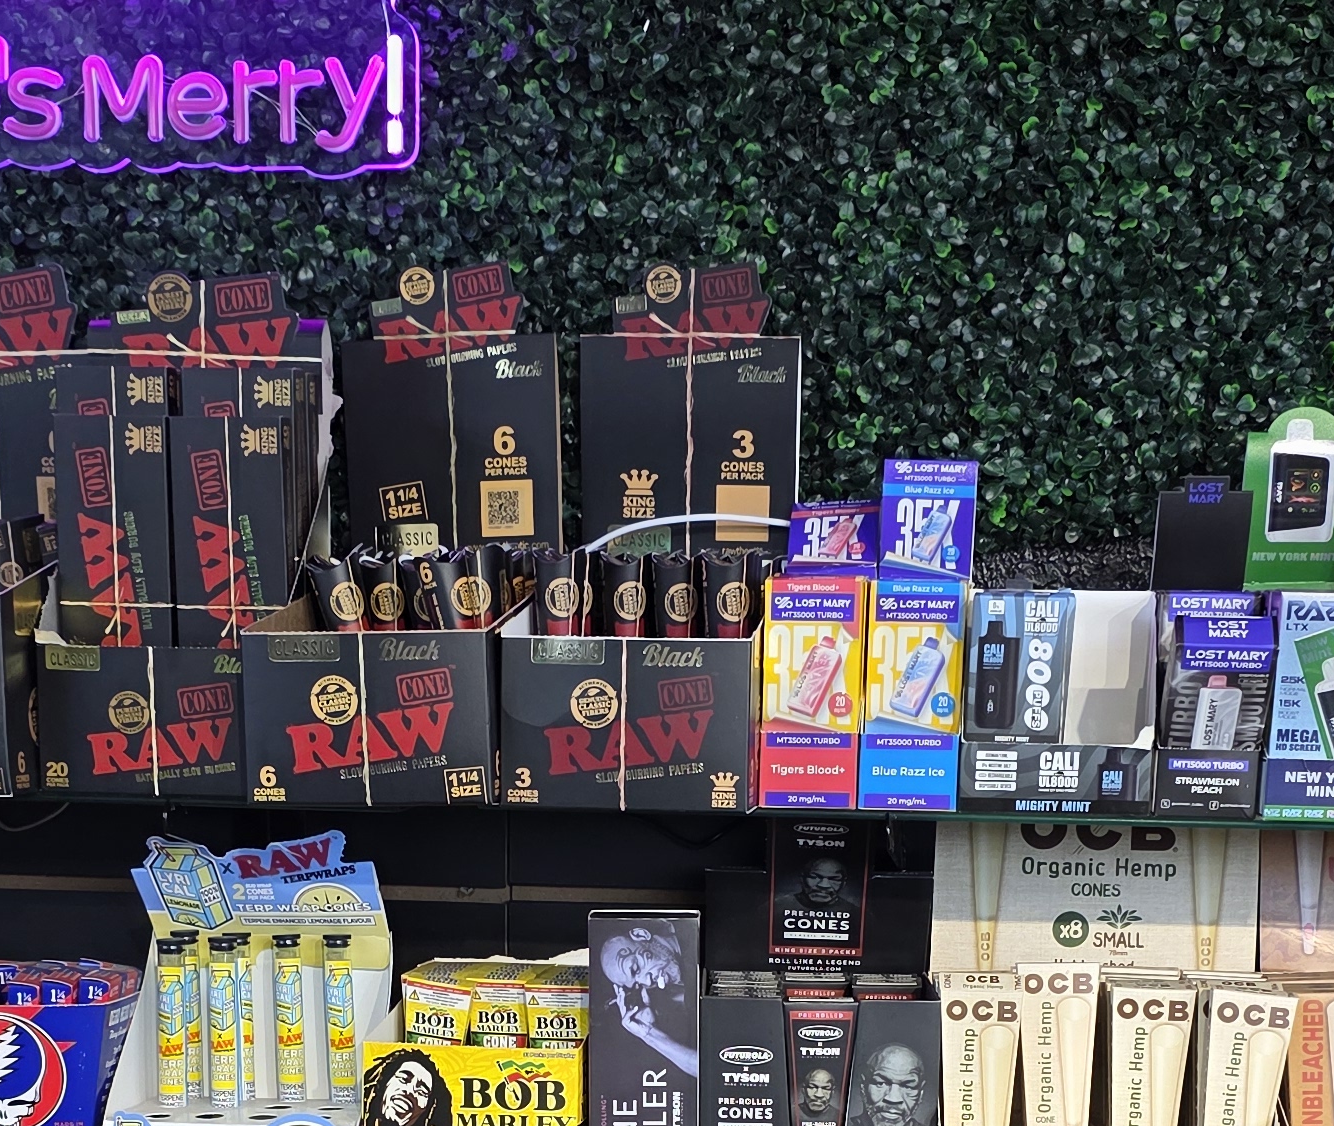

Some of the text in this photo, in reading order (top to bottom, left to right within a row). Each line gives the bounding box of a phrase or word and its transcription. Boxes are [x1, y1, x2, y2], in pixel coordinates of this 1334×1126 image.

[83, 34, 404, 155] Merry!
[914, 463, 966, 474] LOST MARY
[642, 644, 704, 667] Black
[1039, 752, 1080, 773] CALI
[770, 764, 845, 778] Tigers Blood+
[871, 766, 945, 778] Blue Razz Ice
[1175, 777, 1239, 787] STRAWMELON
[1284, 772, 1320, 785] NEW
[1191, 786, 1222, 795] PEACH
[1015, 800, 1091, 812] MIGHTY MINT
[237, 838, 334, 880] RAW
[282, 865, 357, 883] TERPWRAPS
[461, 1079, 565, 1112] BOB
[717, 1106, 773, 1120] CONES
